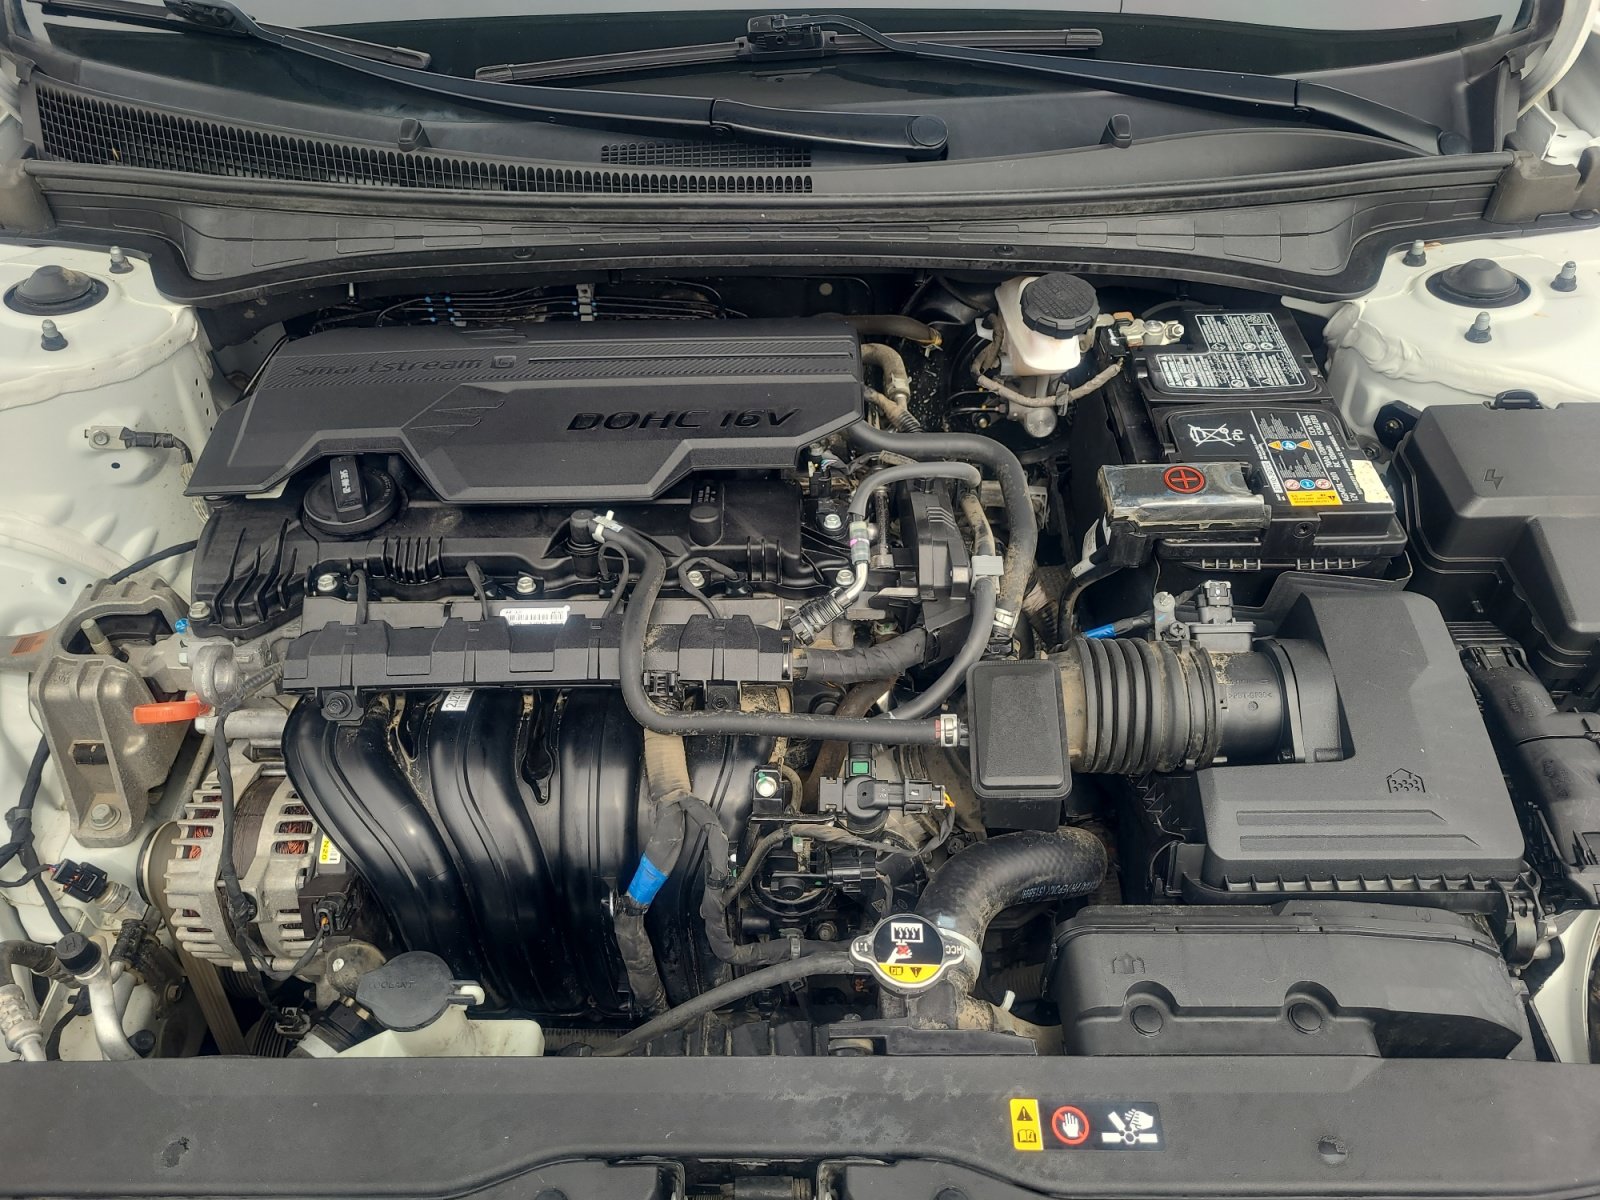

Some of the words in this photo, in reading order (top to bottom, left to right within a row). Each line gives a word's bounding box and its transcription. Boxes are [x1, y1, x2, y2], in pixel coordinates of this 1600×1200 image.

[567, 410, 709, 431] DOHC
[720, 408, 800, 428] 16V
[1232, 429, 1246, 441] Pb
